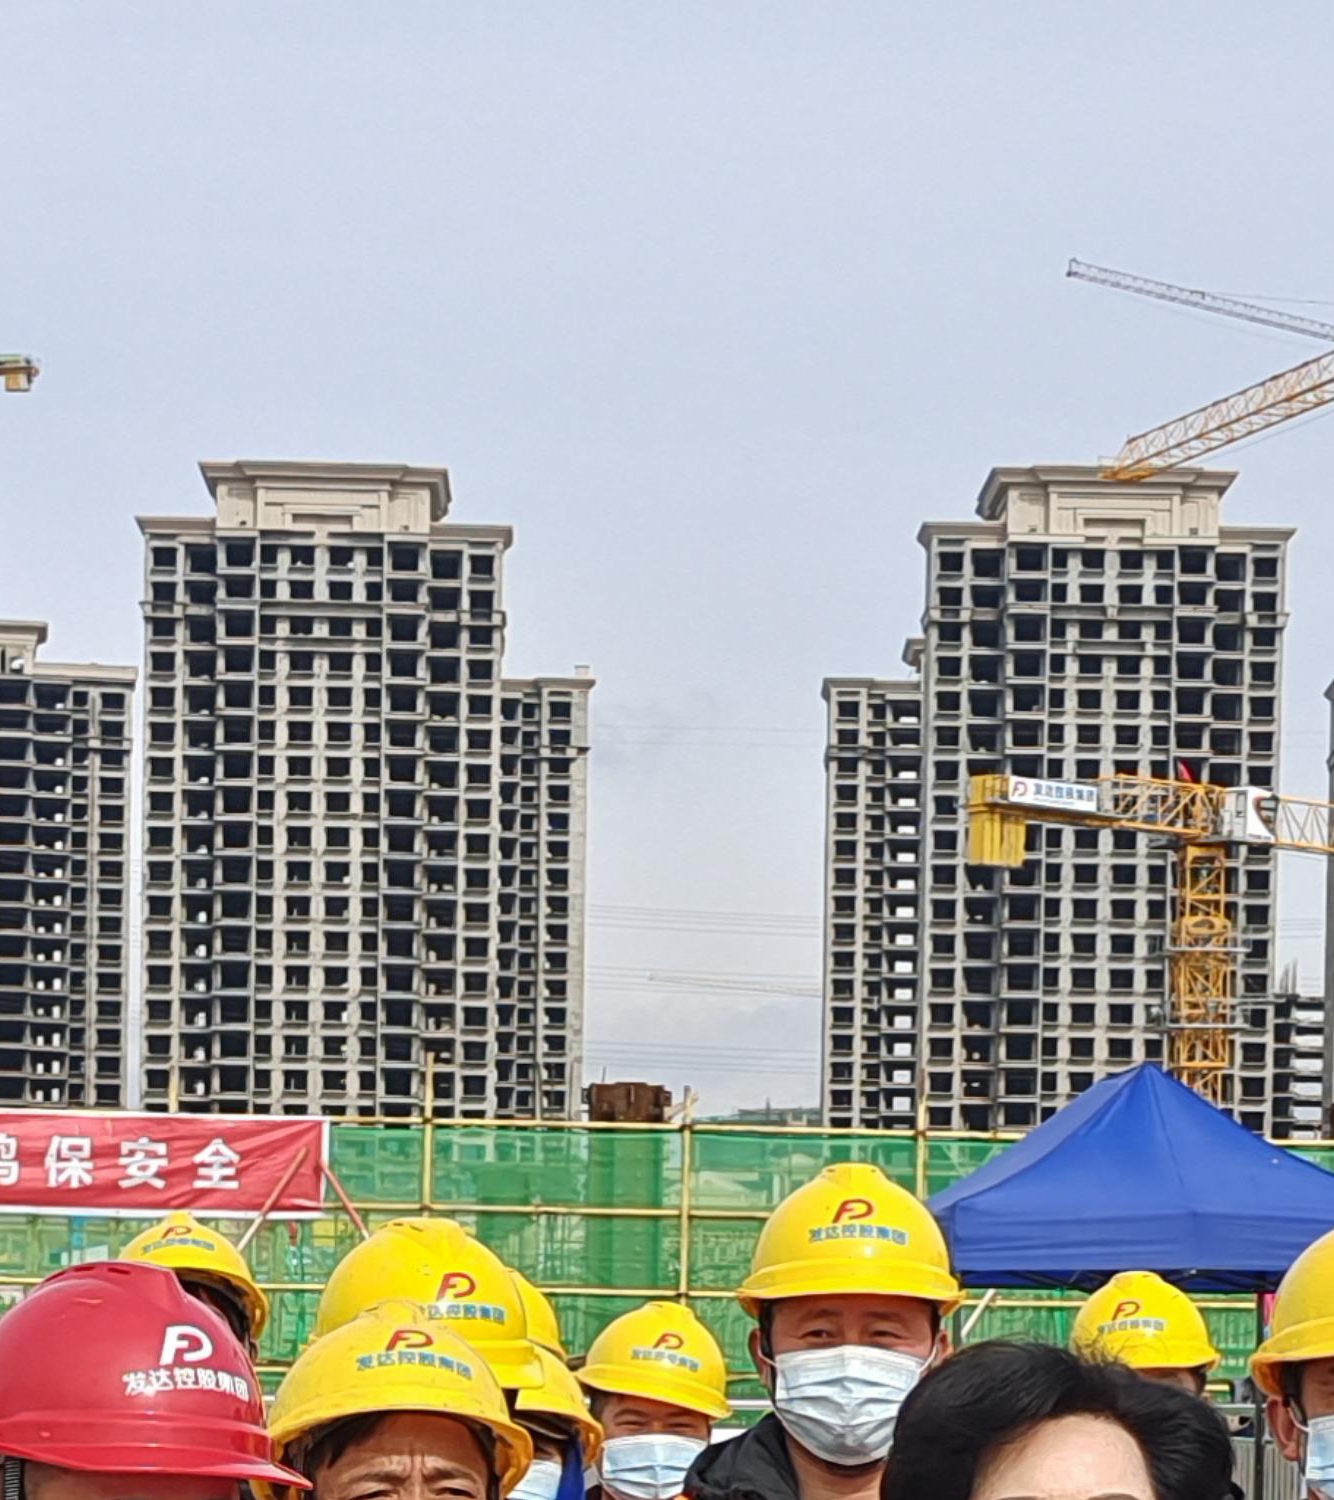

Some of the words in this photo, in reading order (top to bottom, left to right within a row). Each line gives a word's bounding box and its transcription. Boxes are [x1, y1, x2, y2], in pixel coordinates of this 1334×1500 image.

[421, 1303, 505, 1327] 达控股集团
[122, 1366, 251, 1403] 发达控股集团
